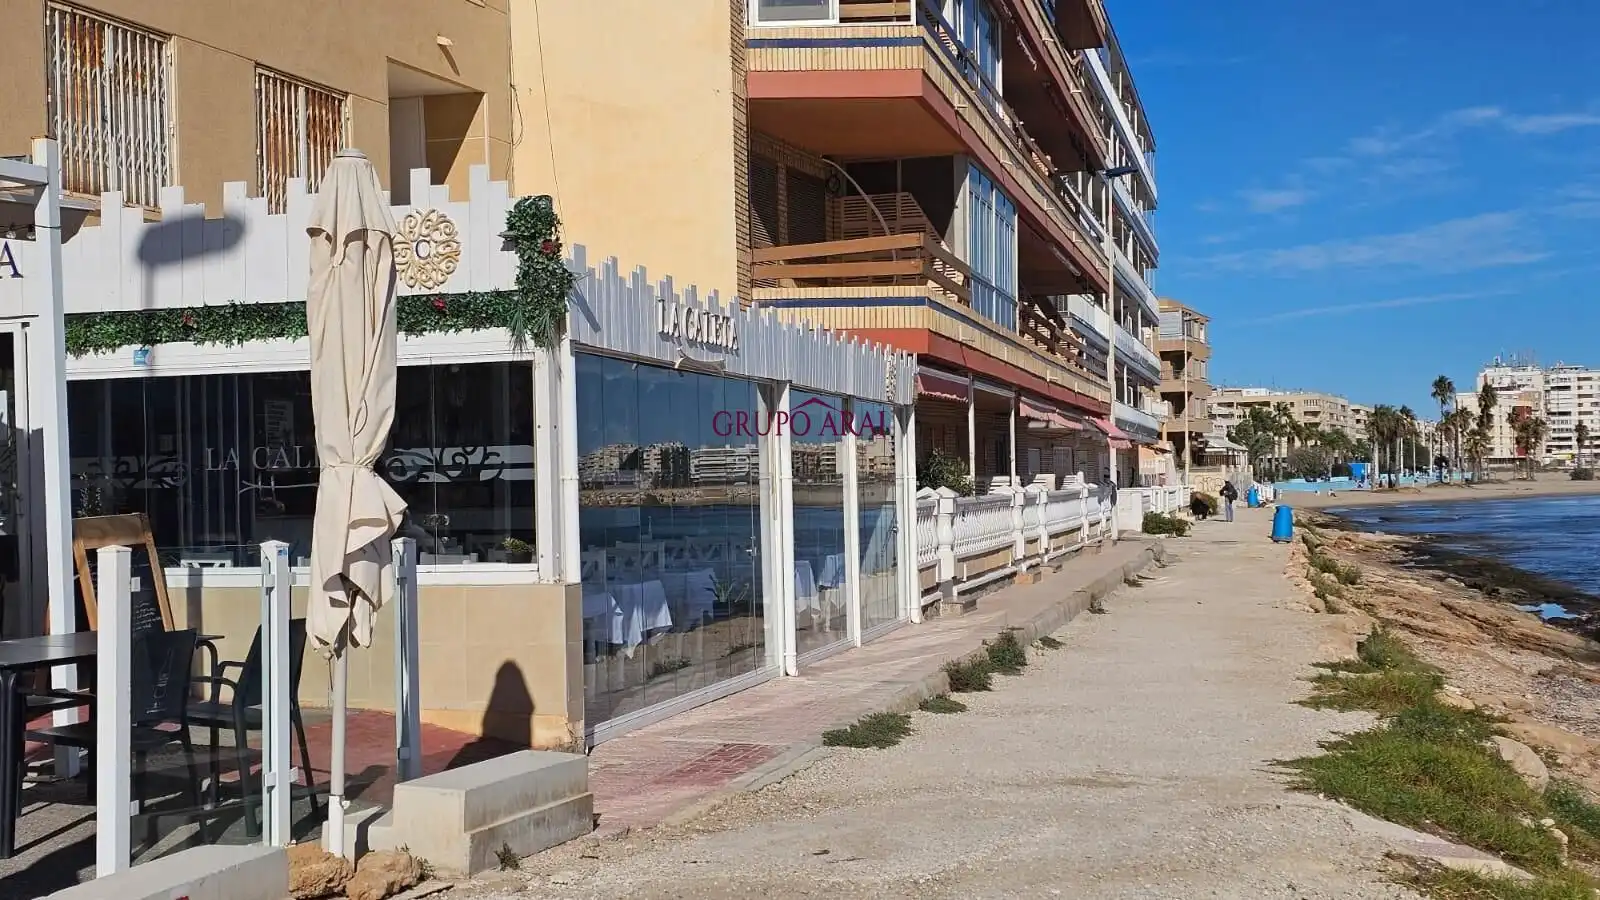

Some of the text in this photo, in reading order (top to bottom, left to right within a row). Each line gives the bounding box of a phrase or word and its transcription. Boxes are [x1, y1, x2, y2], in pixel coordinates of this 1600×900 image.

[657, 297, 740, 351] LA CALETA
[205, 447, 239, 471] LA
